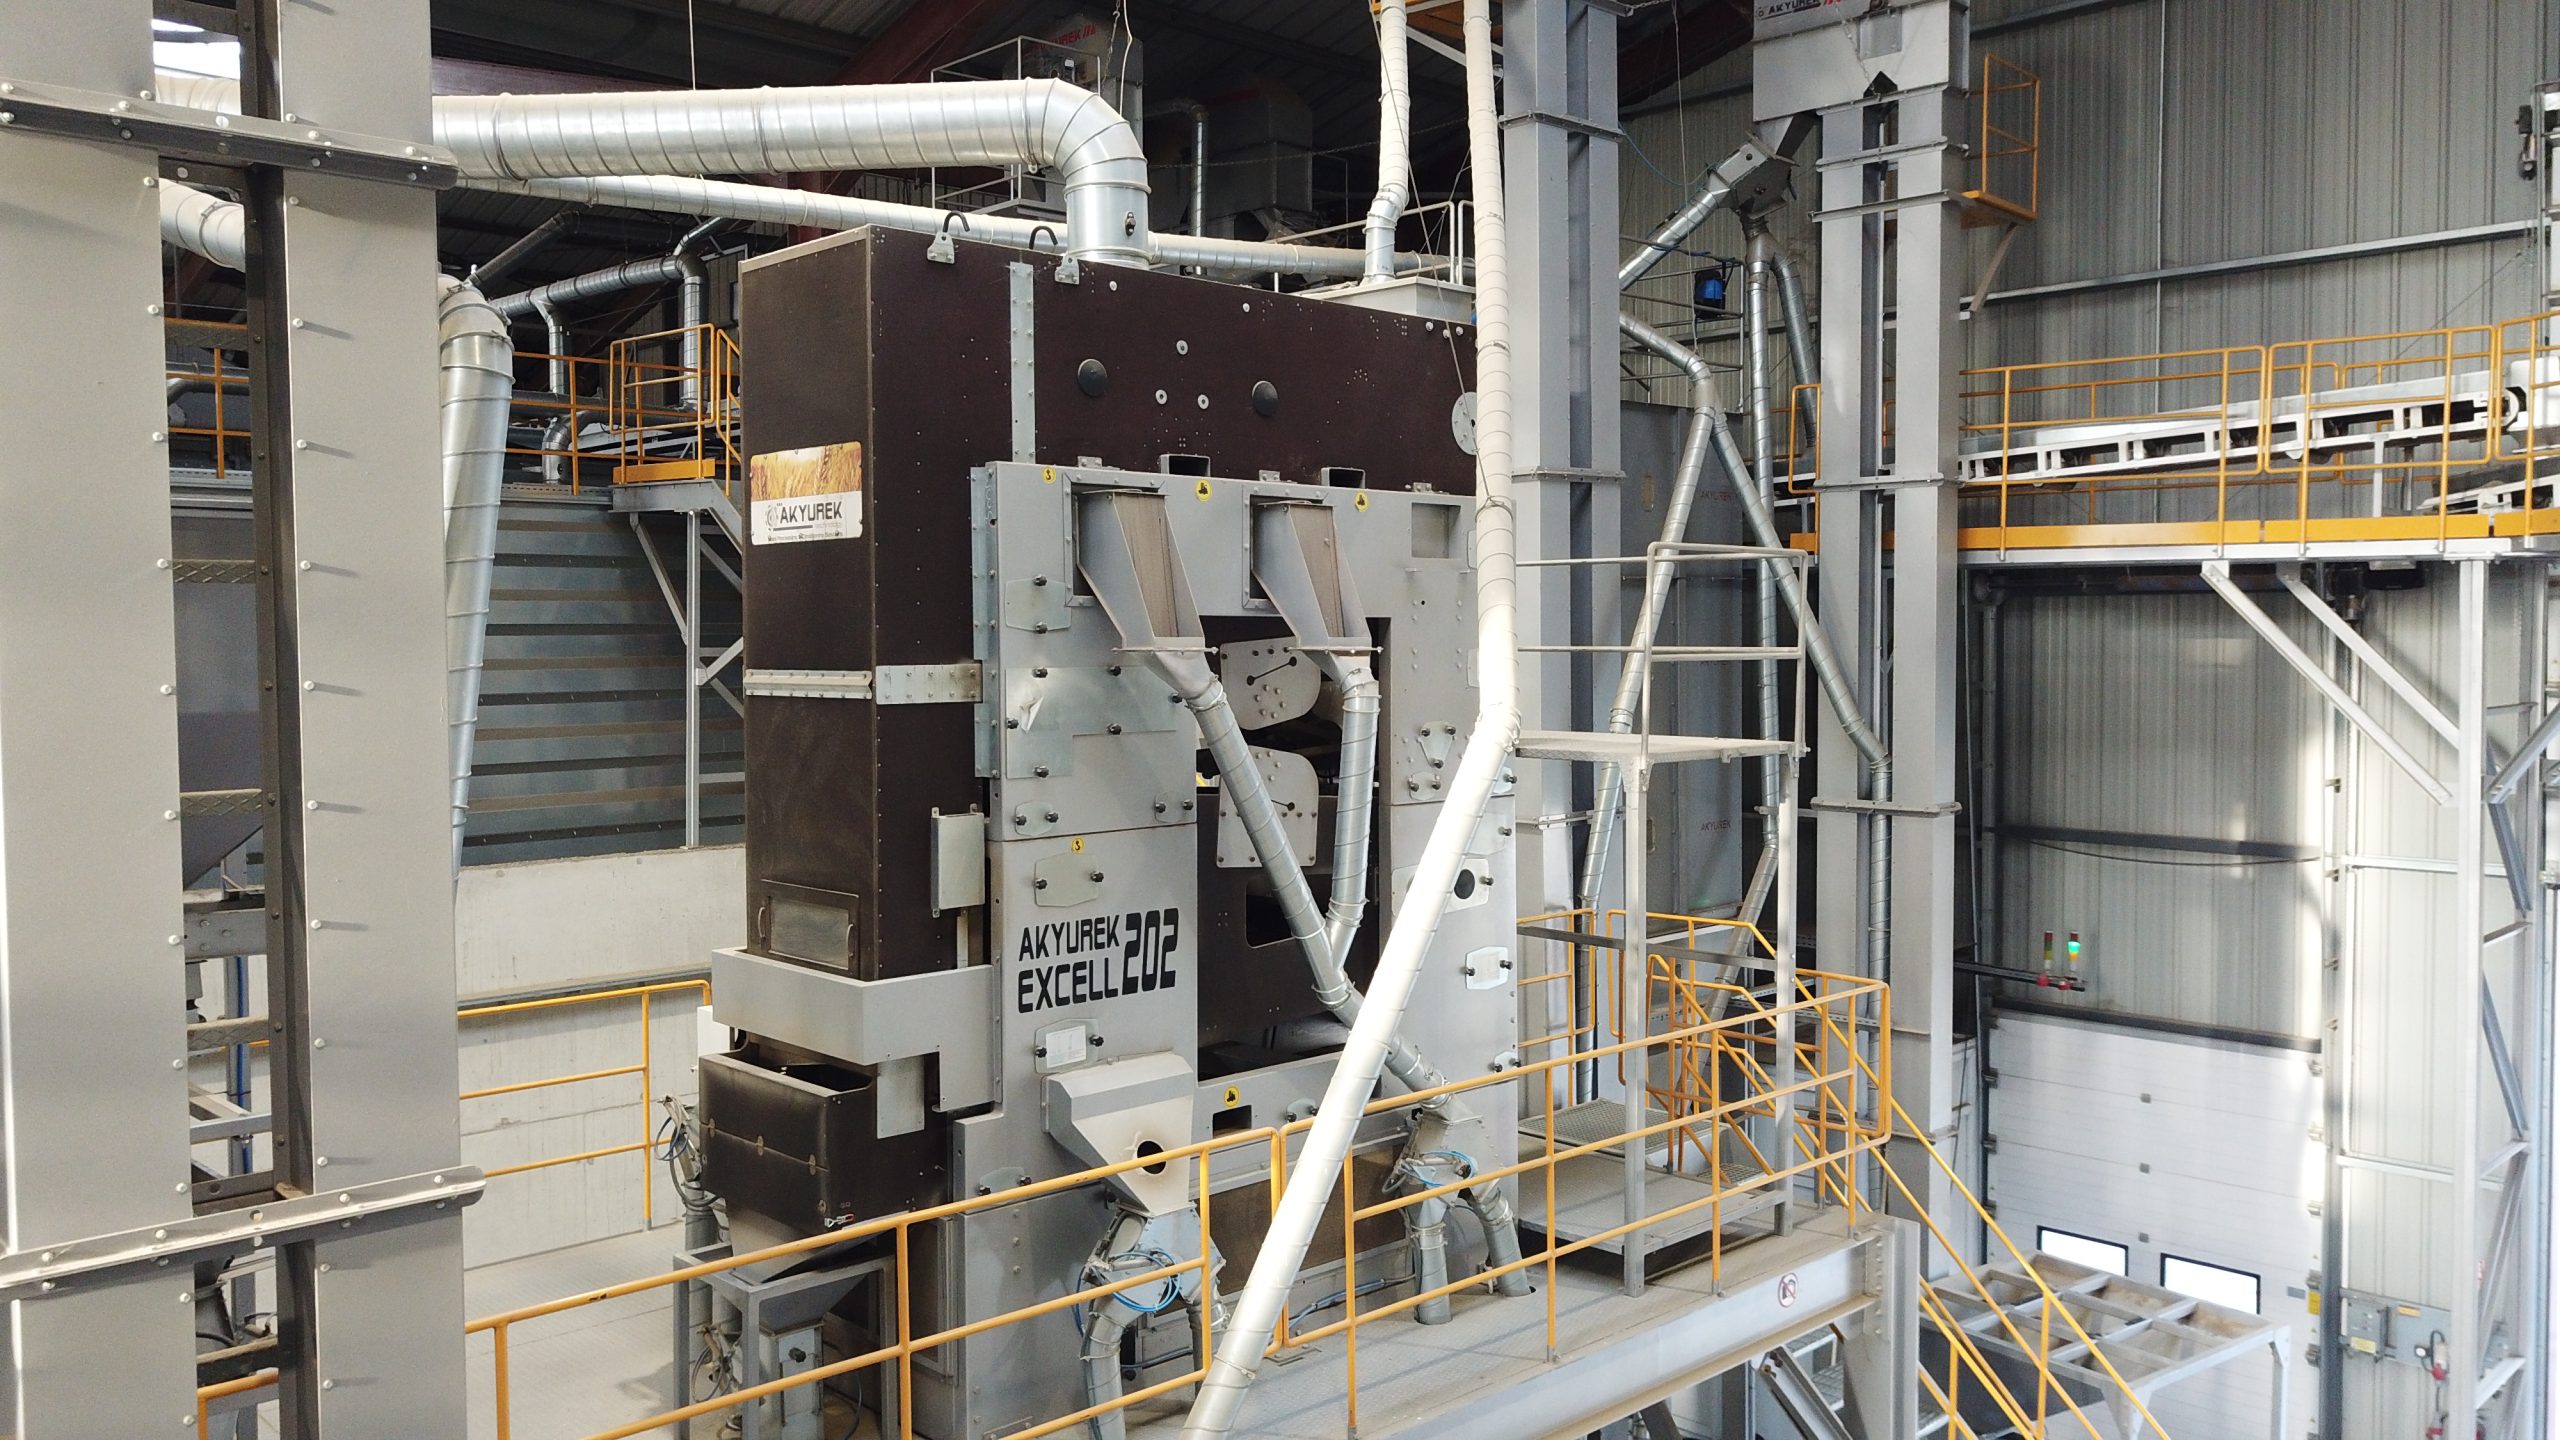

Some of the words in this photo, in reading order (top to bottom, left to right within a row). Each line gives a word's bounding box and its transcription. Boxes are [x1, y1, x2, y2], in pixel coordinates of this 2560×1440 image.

[780, 501, 842, 523] AKYUREK
[1018, 958, 1118, 1013] EXCELL
[1122, 908, 1179, 995] 202
[1019, 915, 1120, 961] AKYUREK
